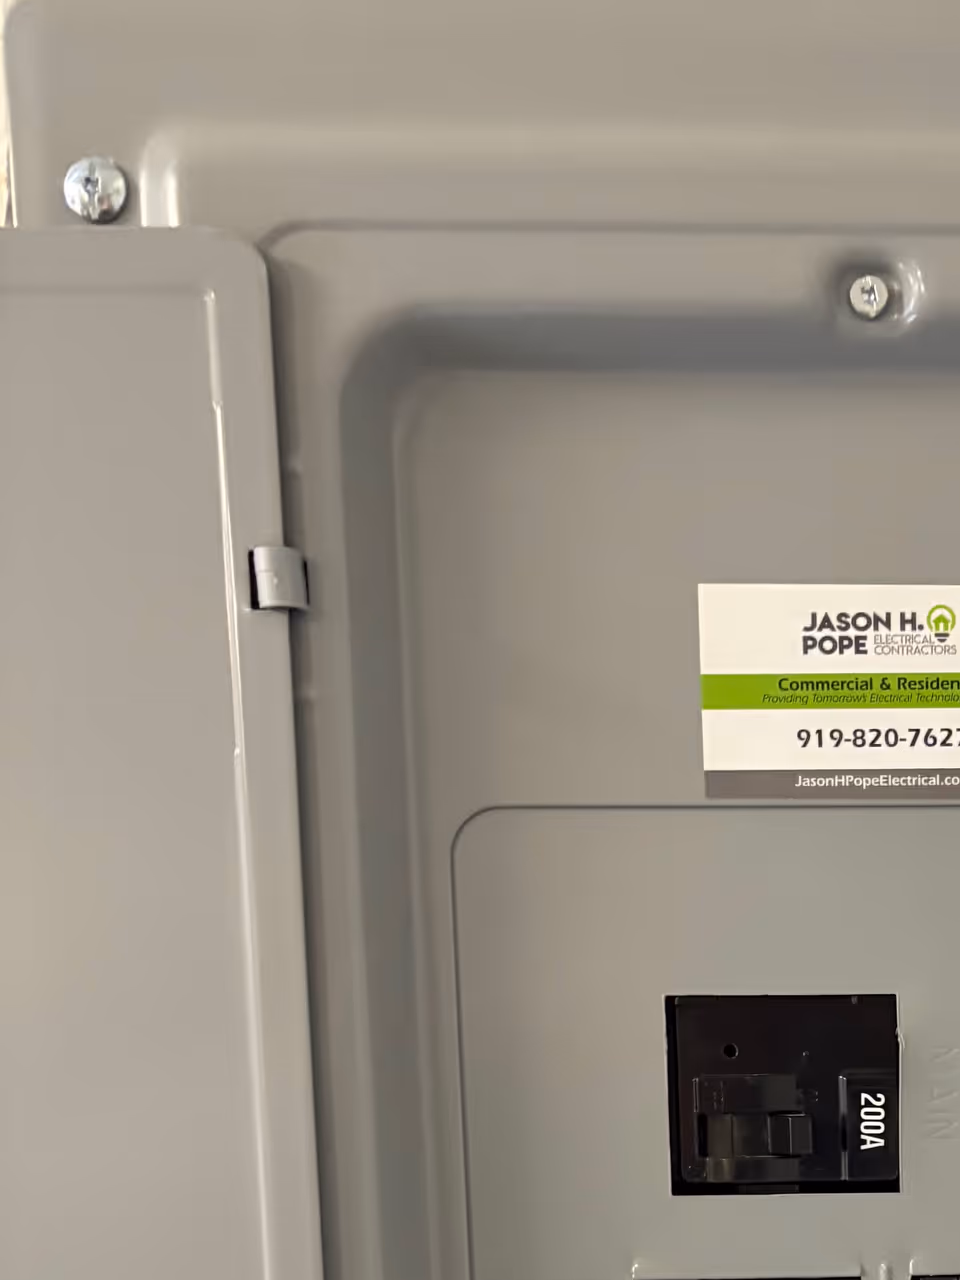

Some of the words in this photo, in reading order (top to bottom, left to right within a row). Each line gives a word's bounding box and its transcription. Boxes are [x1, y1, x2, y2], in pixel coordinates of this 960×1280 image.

[802, 611, 891, 632] JASON
[899, 611, 924, 632] H.
[802, 635, 868, 655] POPE
[874, 634, 935, 645] ELECTRICAL
[874, 645, 957, 656] CONTRACTORS
[778, 677, 873, 691] Commercial
[879, 677, 891, 691] &
[762, 694, 809, 705] Providing
[870, 693, 913, 703] Electrical
[860, 1092, 885, 1150] 200A
